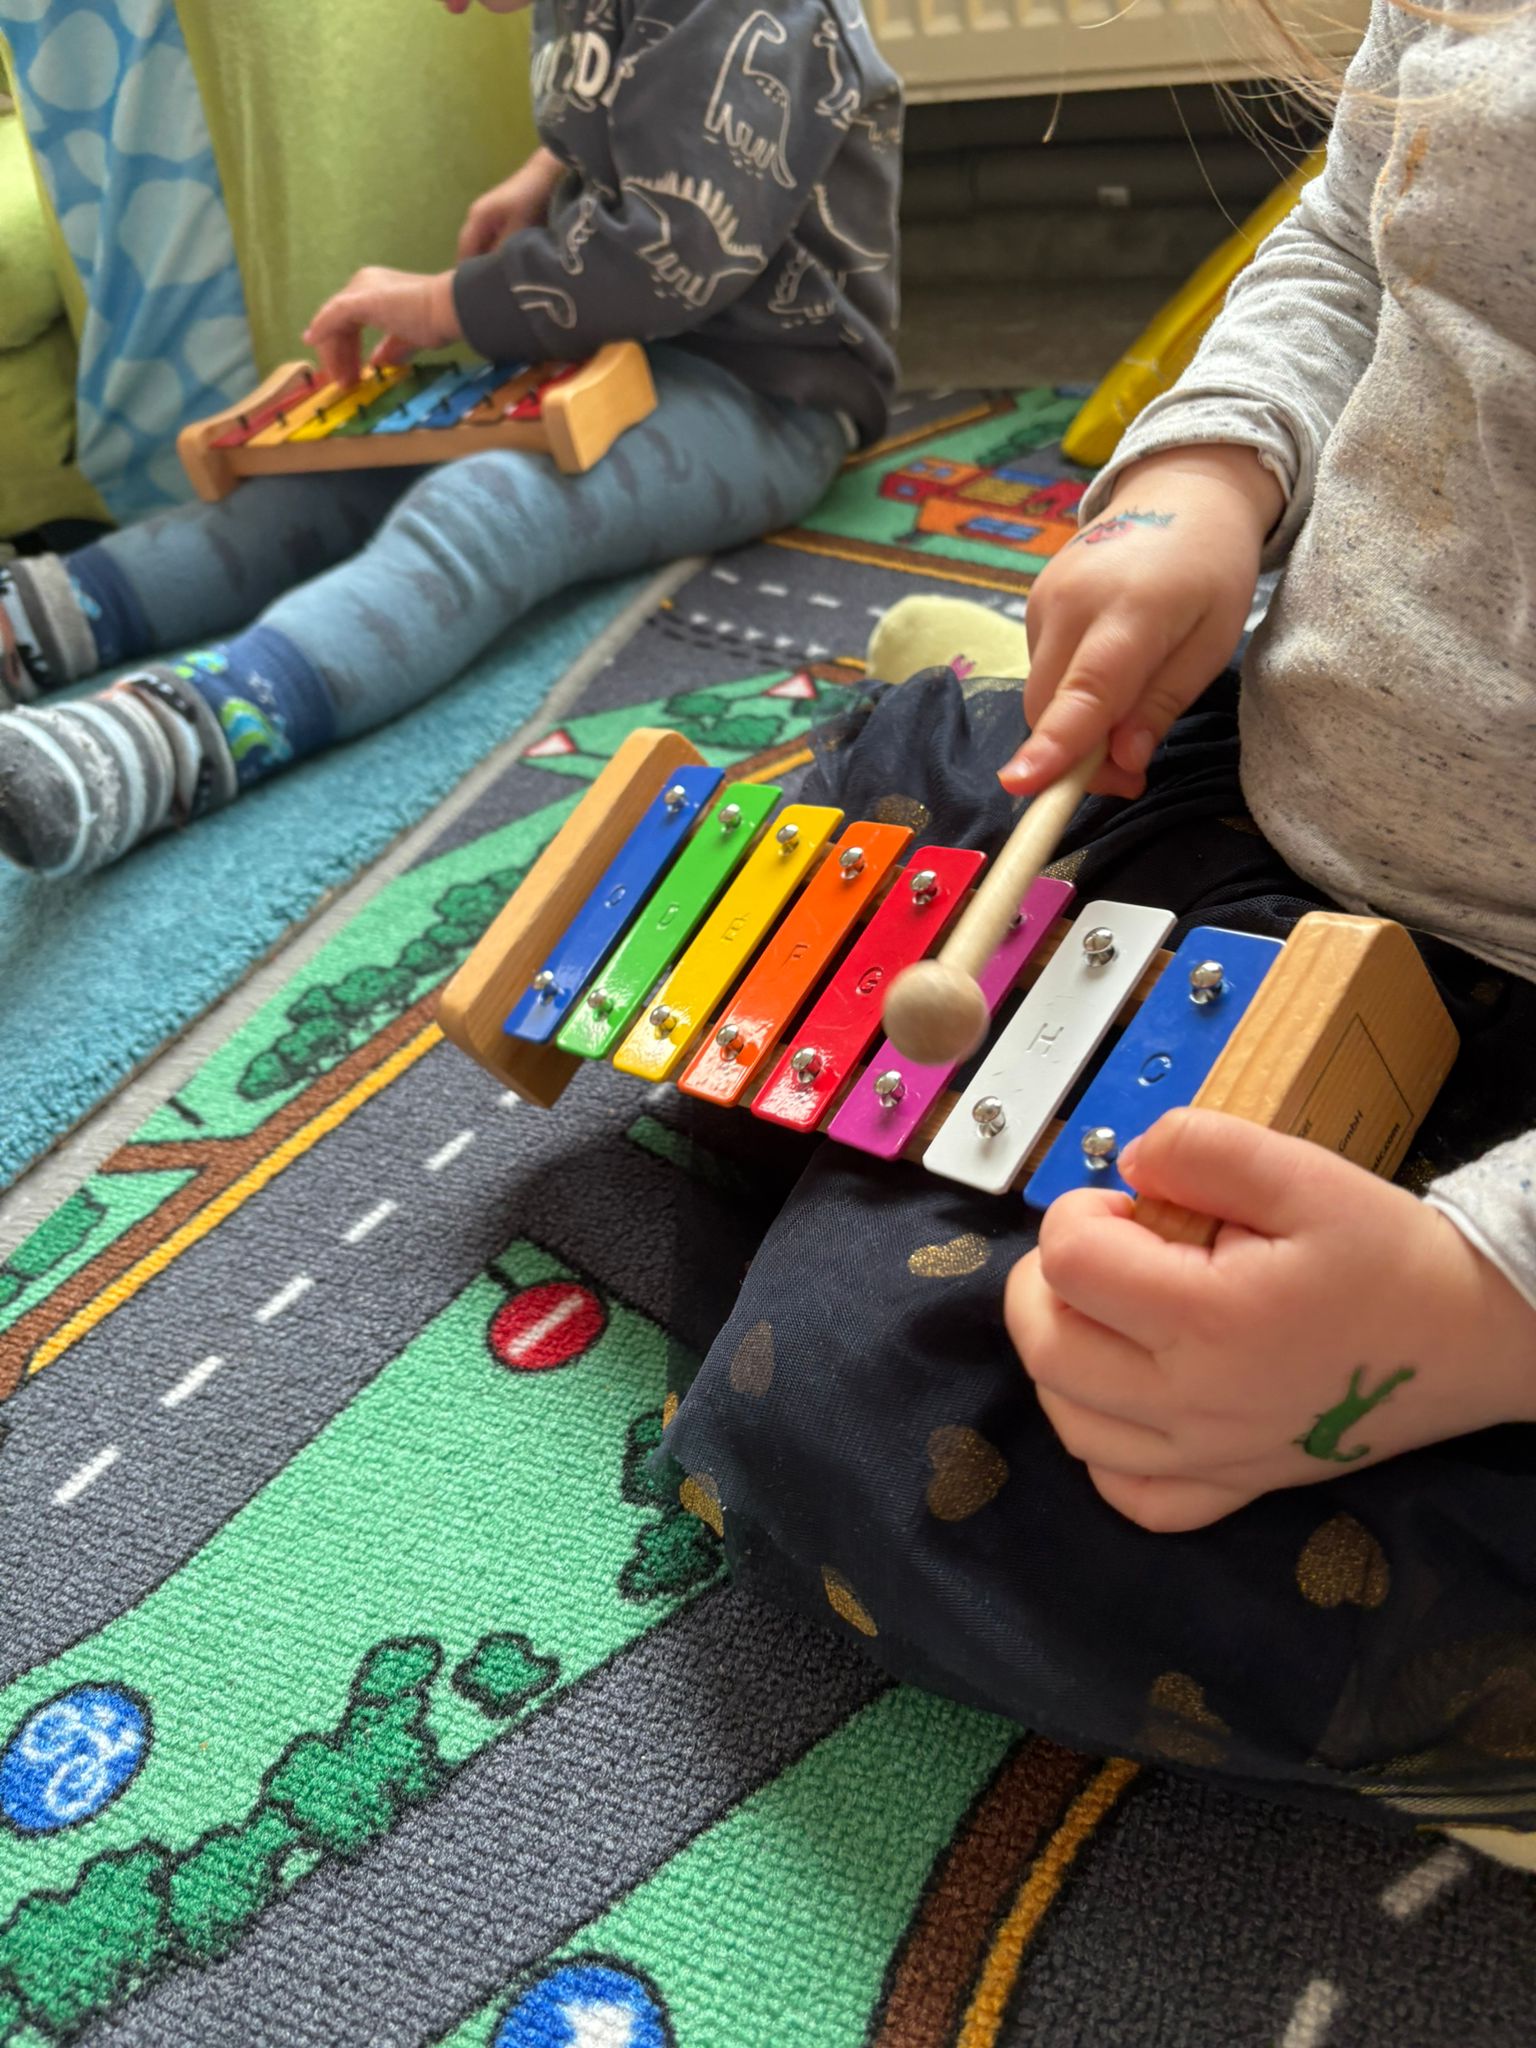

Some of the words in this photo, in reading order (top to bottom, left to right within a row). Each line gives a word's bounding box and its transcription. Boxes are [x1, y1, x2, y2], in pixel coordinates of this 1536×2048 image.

[855, 966, 884, 995] G
[1025, 1022, 1064, 1057] H
[1138, 1052, 1172, 1086] C
[1339, 1110, 1363, 1153] GmbH
